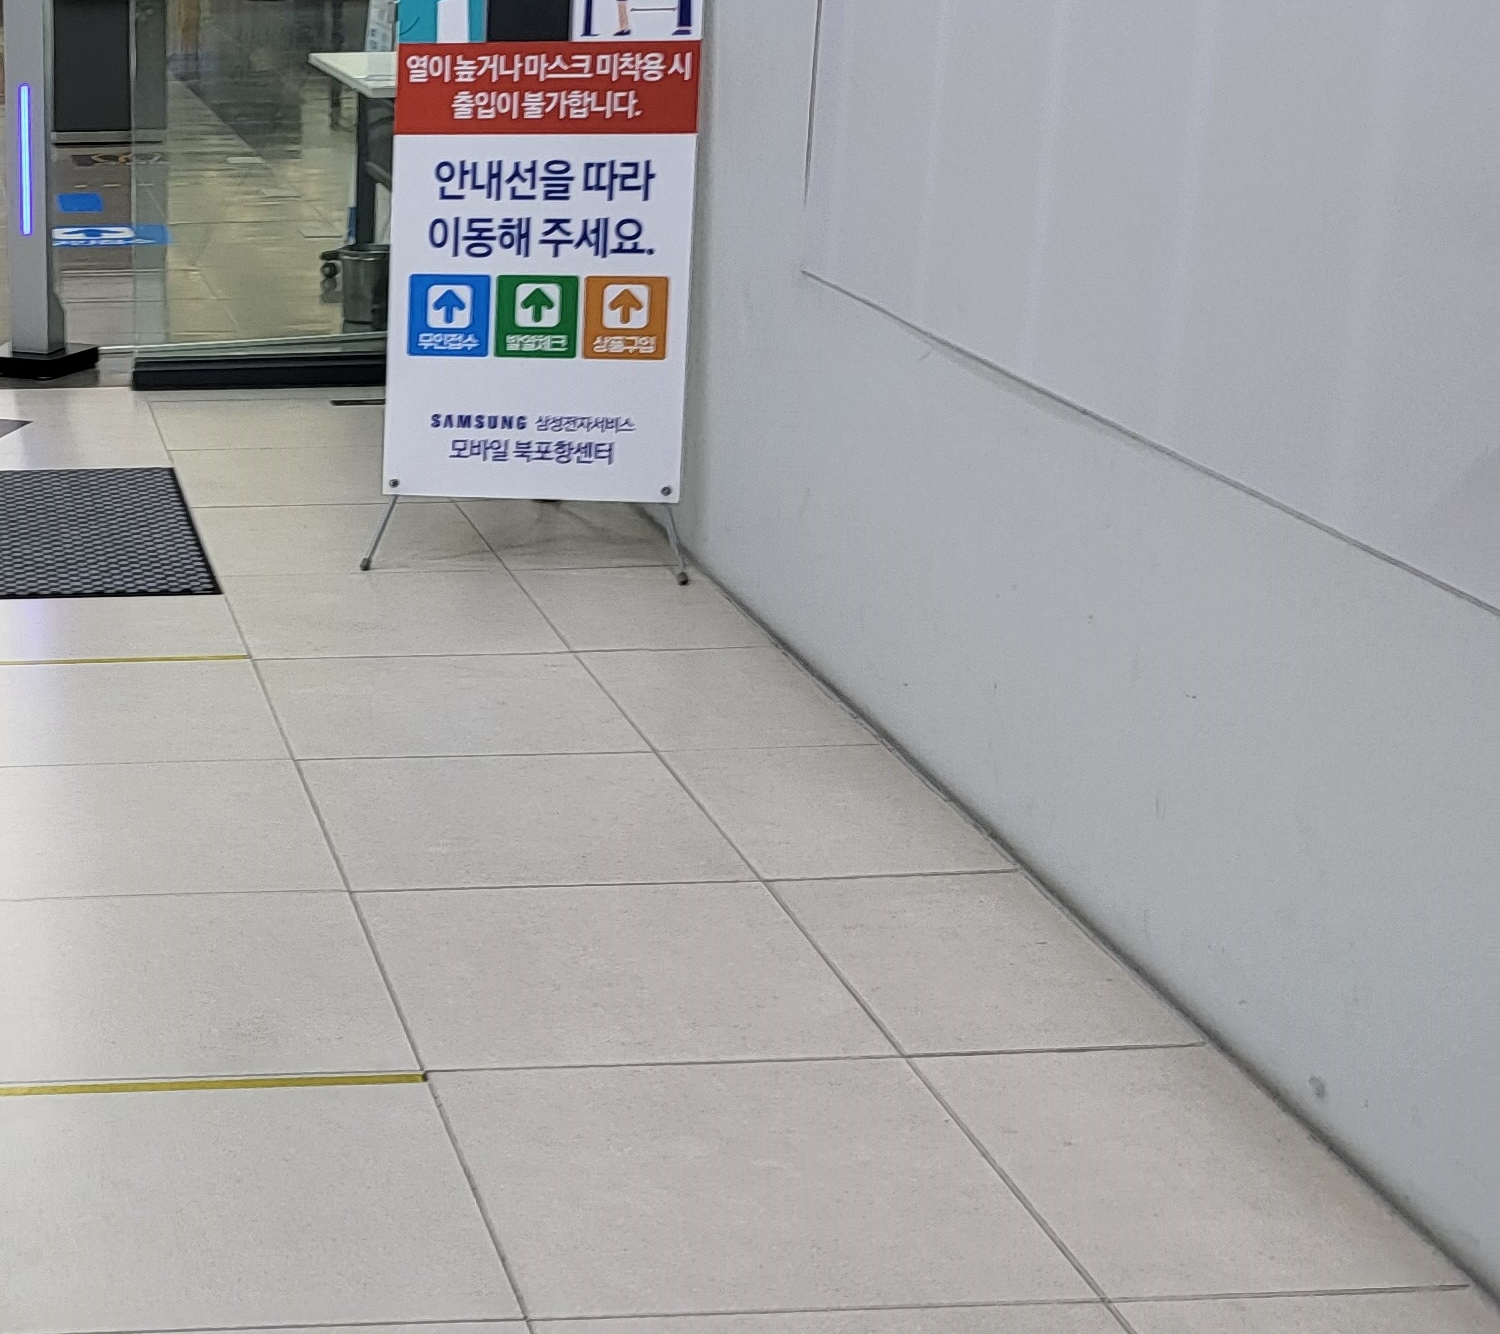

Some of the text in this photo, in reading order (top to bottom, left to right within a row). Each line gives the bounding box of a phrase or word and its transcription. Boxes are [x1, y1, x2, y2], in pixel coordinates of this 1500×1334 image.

[406, 51, 694, 83] 열이 높거나 마스크 미착용 시
[451, 90, 643, 119] 출입이 불가합니다.
[434, 159, 655, 201] 안내선을 따라
[428, 217, 655, 259] 이동해 주세요.
[430, 413, 636, 434] SAMSUNG 삼성전자서비스
[449, 438, 616, 465] 모바일 북포항센터
